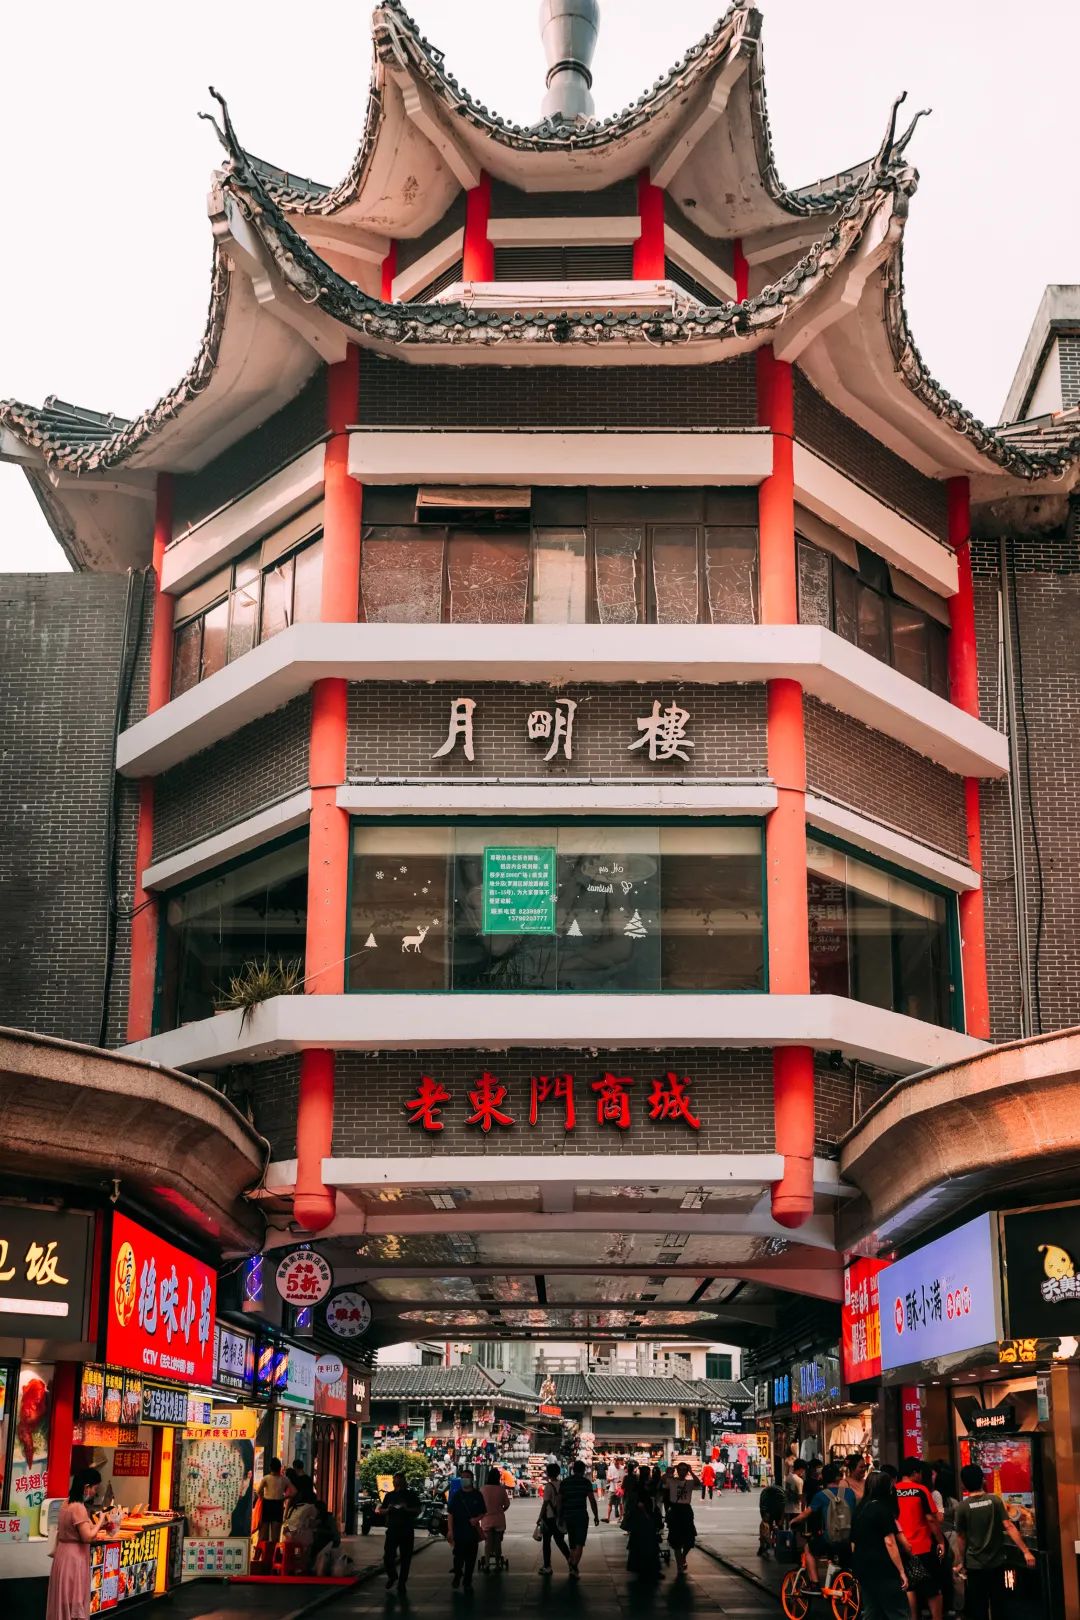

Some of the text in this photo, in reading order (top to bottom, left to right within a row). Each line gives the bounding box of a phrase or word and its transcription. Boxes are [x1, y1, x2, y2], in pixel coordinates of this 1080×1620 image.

[404, 1071, 702, 1133] 老東門商城
[317, 1364, 341, 1373] 便利店
